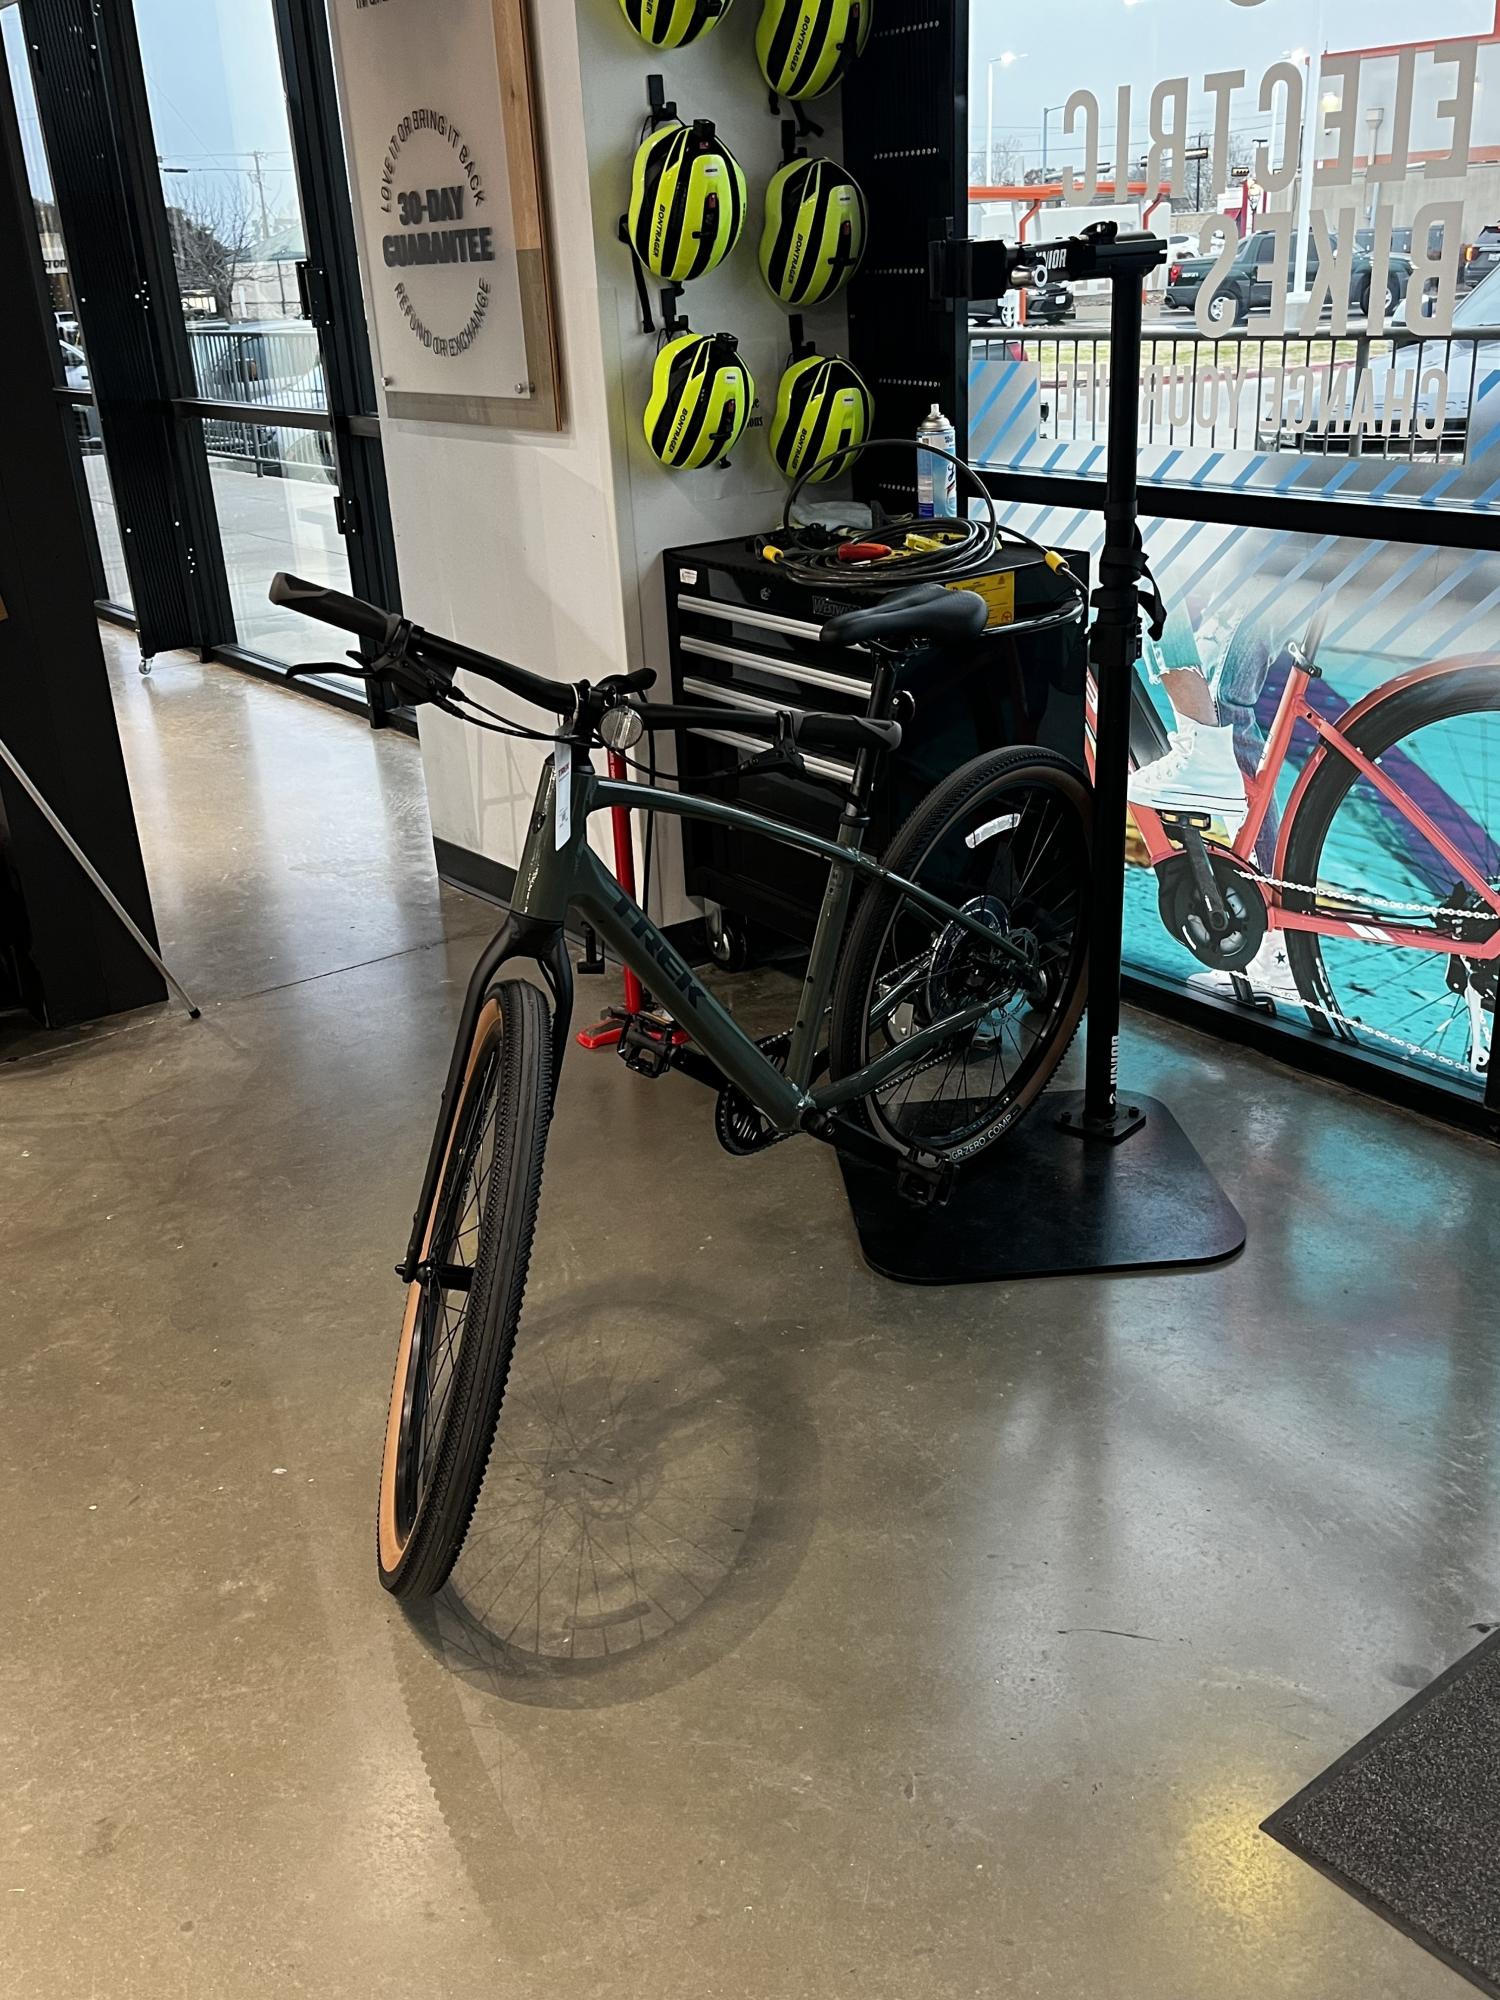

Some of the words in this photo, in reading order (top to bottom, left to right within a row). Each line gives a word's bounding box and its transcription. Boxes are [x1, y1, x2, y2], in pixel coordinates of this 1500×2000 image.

[789, 15, 811, 73] BONTRAGER
[381, 157, 396, 213] LOVE
[389, 135, 400, 160] IT
[397, 116, 412, 143] OR
[412, 109, 445, 136] BRING
[448, 125, 460, 149] IT
[459, 145, 485, 207] BACK
[397, 185, 464, 226] 30-DAY
[653, 203, 666, 257] BONTRAGER
[382, 227, 495, 267] GUARANTEE
[788, 233, 803, 284] BONTRAGER
[395, 282, 432, 348] REFUND
[449, 278, 490, 356] EXCHANGE
[669, 408, 688, 453] BONTRAGER
[613, 896, 707, 1009] TREK
[951, 1137, 986, 1160] GR-ZERO
[987, 1114, 1012, 1139] COMP
